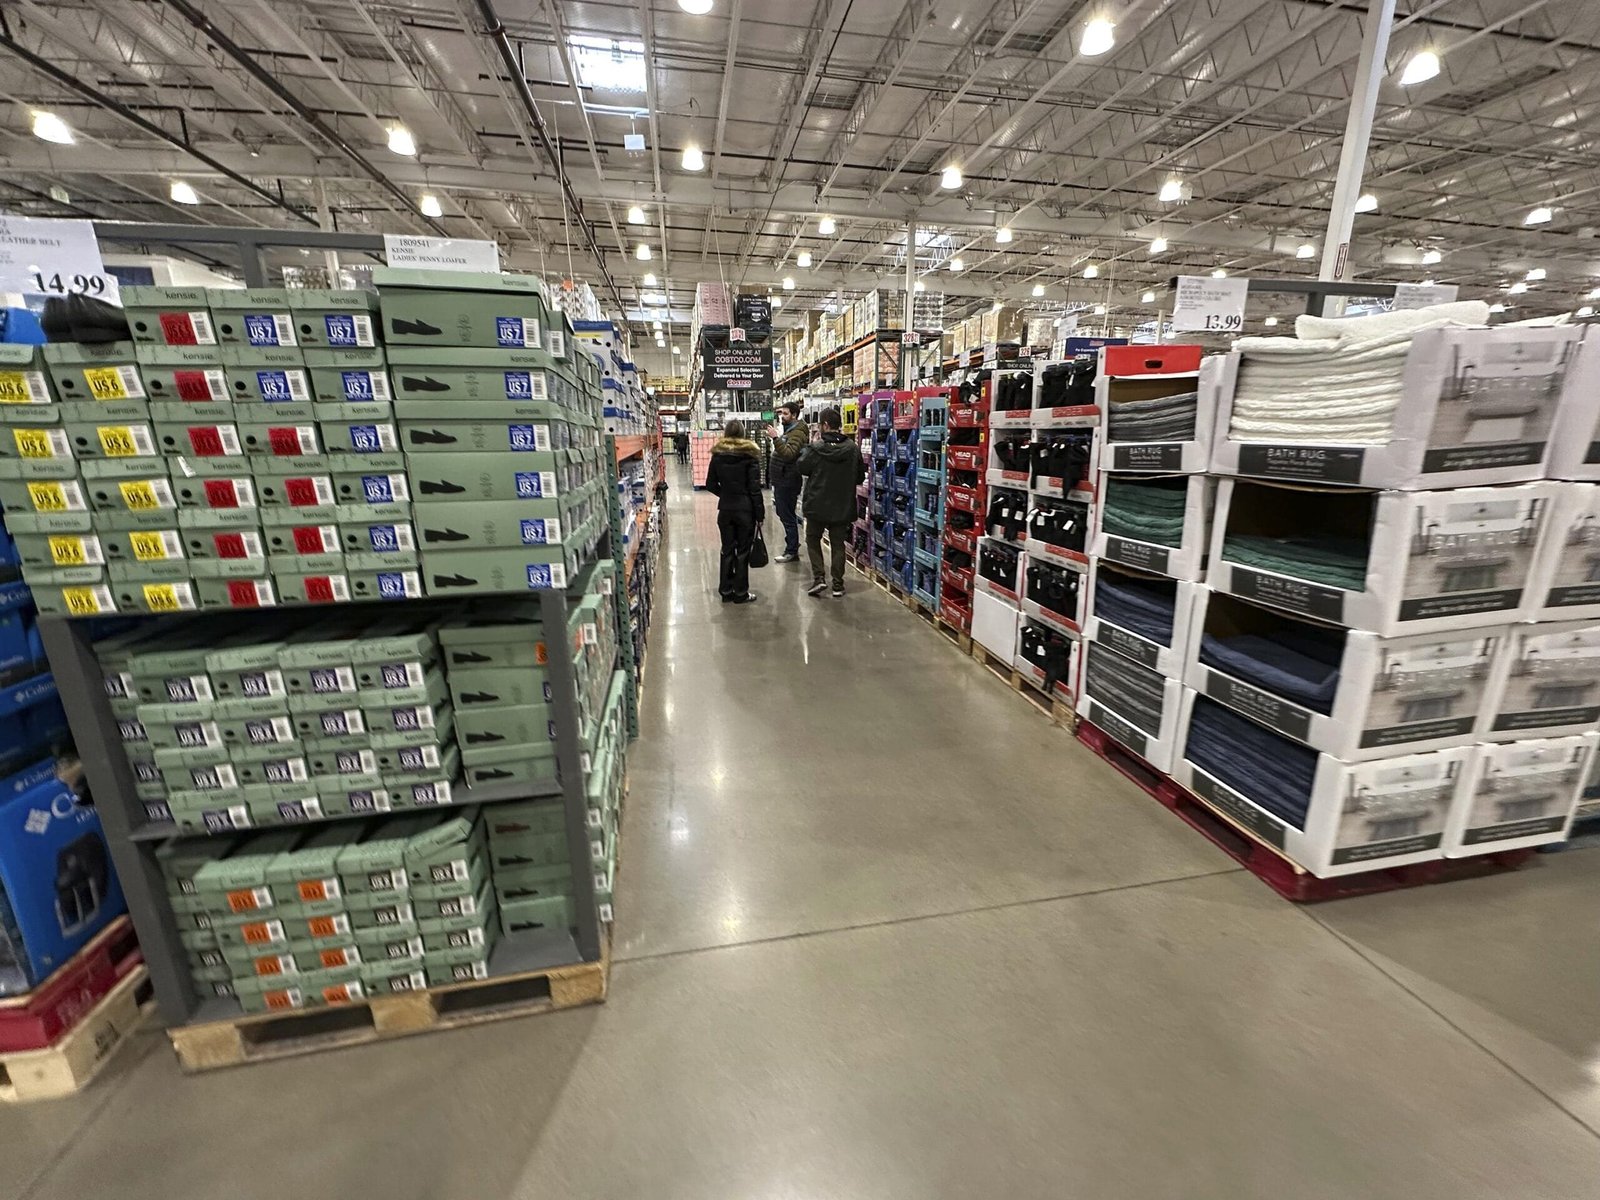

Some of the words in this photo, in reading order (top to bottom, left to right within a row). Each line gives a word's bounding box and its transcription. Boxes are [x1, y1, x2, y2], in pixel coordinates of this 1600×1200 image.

[1204, 315, 1242, 330] 13.99
[251, 326, 265, 338] US
[266, 327, 272, 338] 7
[330, 326, 344, 338] US
[346, 327, 350, 338] 7
[500, 328, 513, 339] US
[514, 329, 520, 339] 7
[17, 383, 24, 394] 6
[94, 380, 110, 392] US
[111, 379, 118, 390] 6
[263, 382, 276, 394] US
[278, 382, 284, 394] 7
[347, 382, 360, 394] US
[362, 382, 368, 394] 7
[508, 382, 522, 393] US
[522, 382, 528, 392] 7
[22, 440, 37, 451] US
[39, 440, 46, 450] 6
[106, 438, 121, 449] US
[123, 438, 130, 448] 6
[355, 438, 369, 448] US
[370, 438, 376, 448] 7
[512, 434, 526, 446] US
[526, 434, 531, 445] 7
[1267, 448, 1296, 458] BATH
[1300, 450, 1326, 460] RUG
[366, 486, 380, 497] US
[381, 486, 387, 496] 7
[519, 482, 532, 494] US
[532, 482, 538, 492] 7
[36, 493, 52, 504] US
[54, 493, 60, 502] 6
[127, 492, 142, 504] US
[144, 492, 151, 501] 6
[524, 528, 536, 540] US
[537, 528, 542, 538] 7
[374, 535, 387, 546] US
[388, 535, 394, 546] 7
[56, 546, 71, 558] US
[72, 547, 80, 556] 6
[137, 542, 152, 554] US
[154, 543, 160, 552] 6
[1256, 576, 1283, 588] BATH
[1286, 582, 1310, 594] RUG
[70, 597, 85, 608] US
[86, 598, 92, 607] 6
